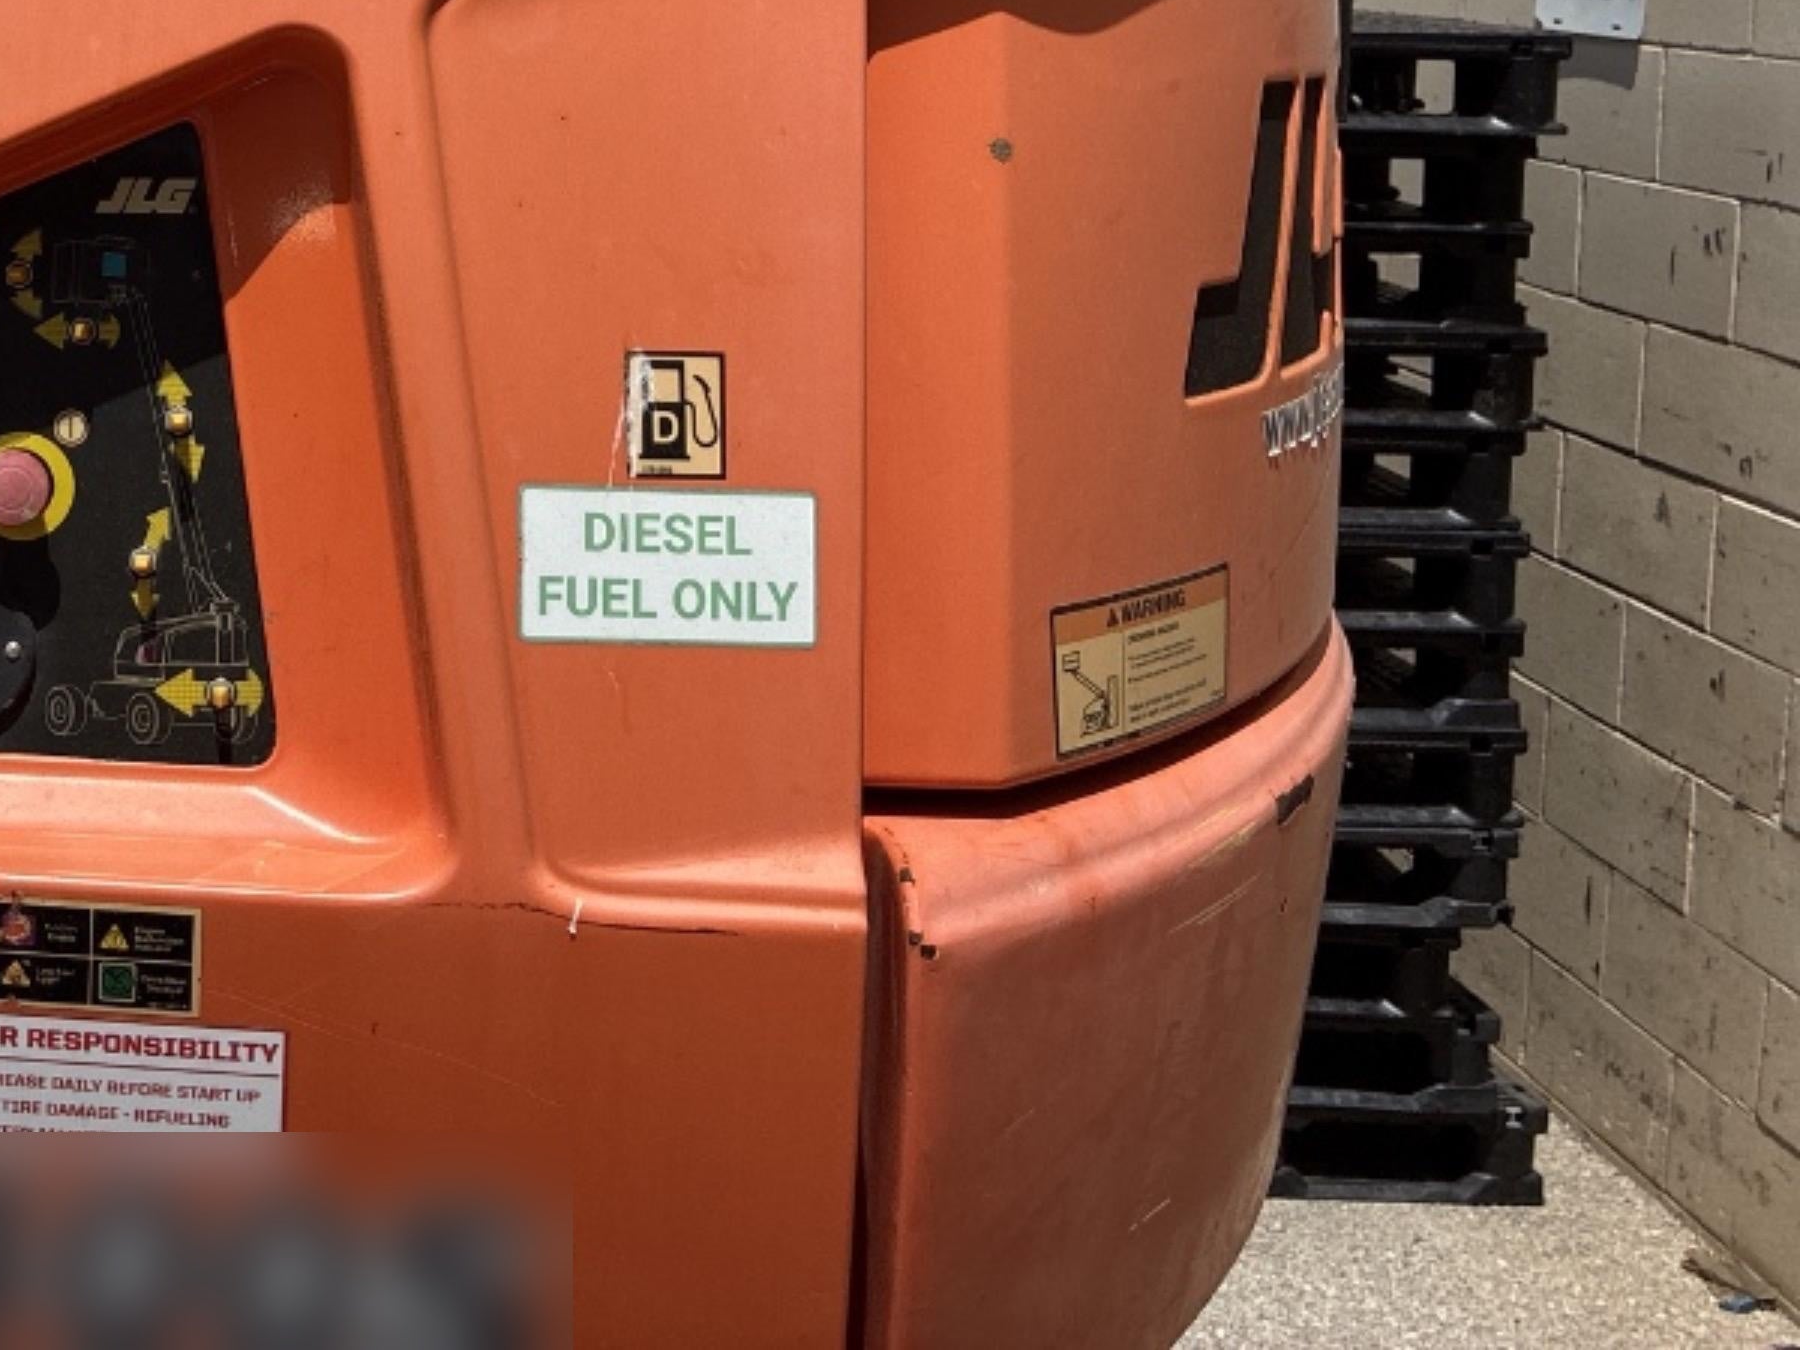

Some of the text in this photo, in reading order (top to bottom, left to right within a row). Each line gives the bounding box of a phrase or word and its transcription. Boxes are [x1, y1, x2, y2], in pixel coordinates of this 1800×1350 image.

[95, 177, 198, 214] JLG
[651, 410, 679, 444] D
[584, 512, 752, 556] DIESEL
[538, 576, 798, 622] FUEL ONLY
[1121, 588, 1186, 623] WARNING
[26, 1028, 279, 1064] RESPONSIBILITY
[52, 1076, 103, 1094] DAILY
[107, 1080, 171, 1099] BEFORE
[176, 1085, 231, 1102] START
[236, 1088, 262, 1104] UP
[3, 1100, 39, 1115] TIRE
[47, 1102, 118, 1120] DAMAGE
[134, 1109, 230, 1129] REFUELING
